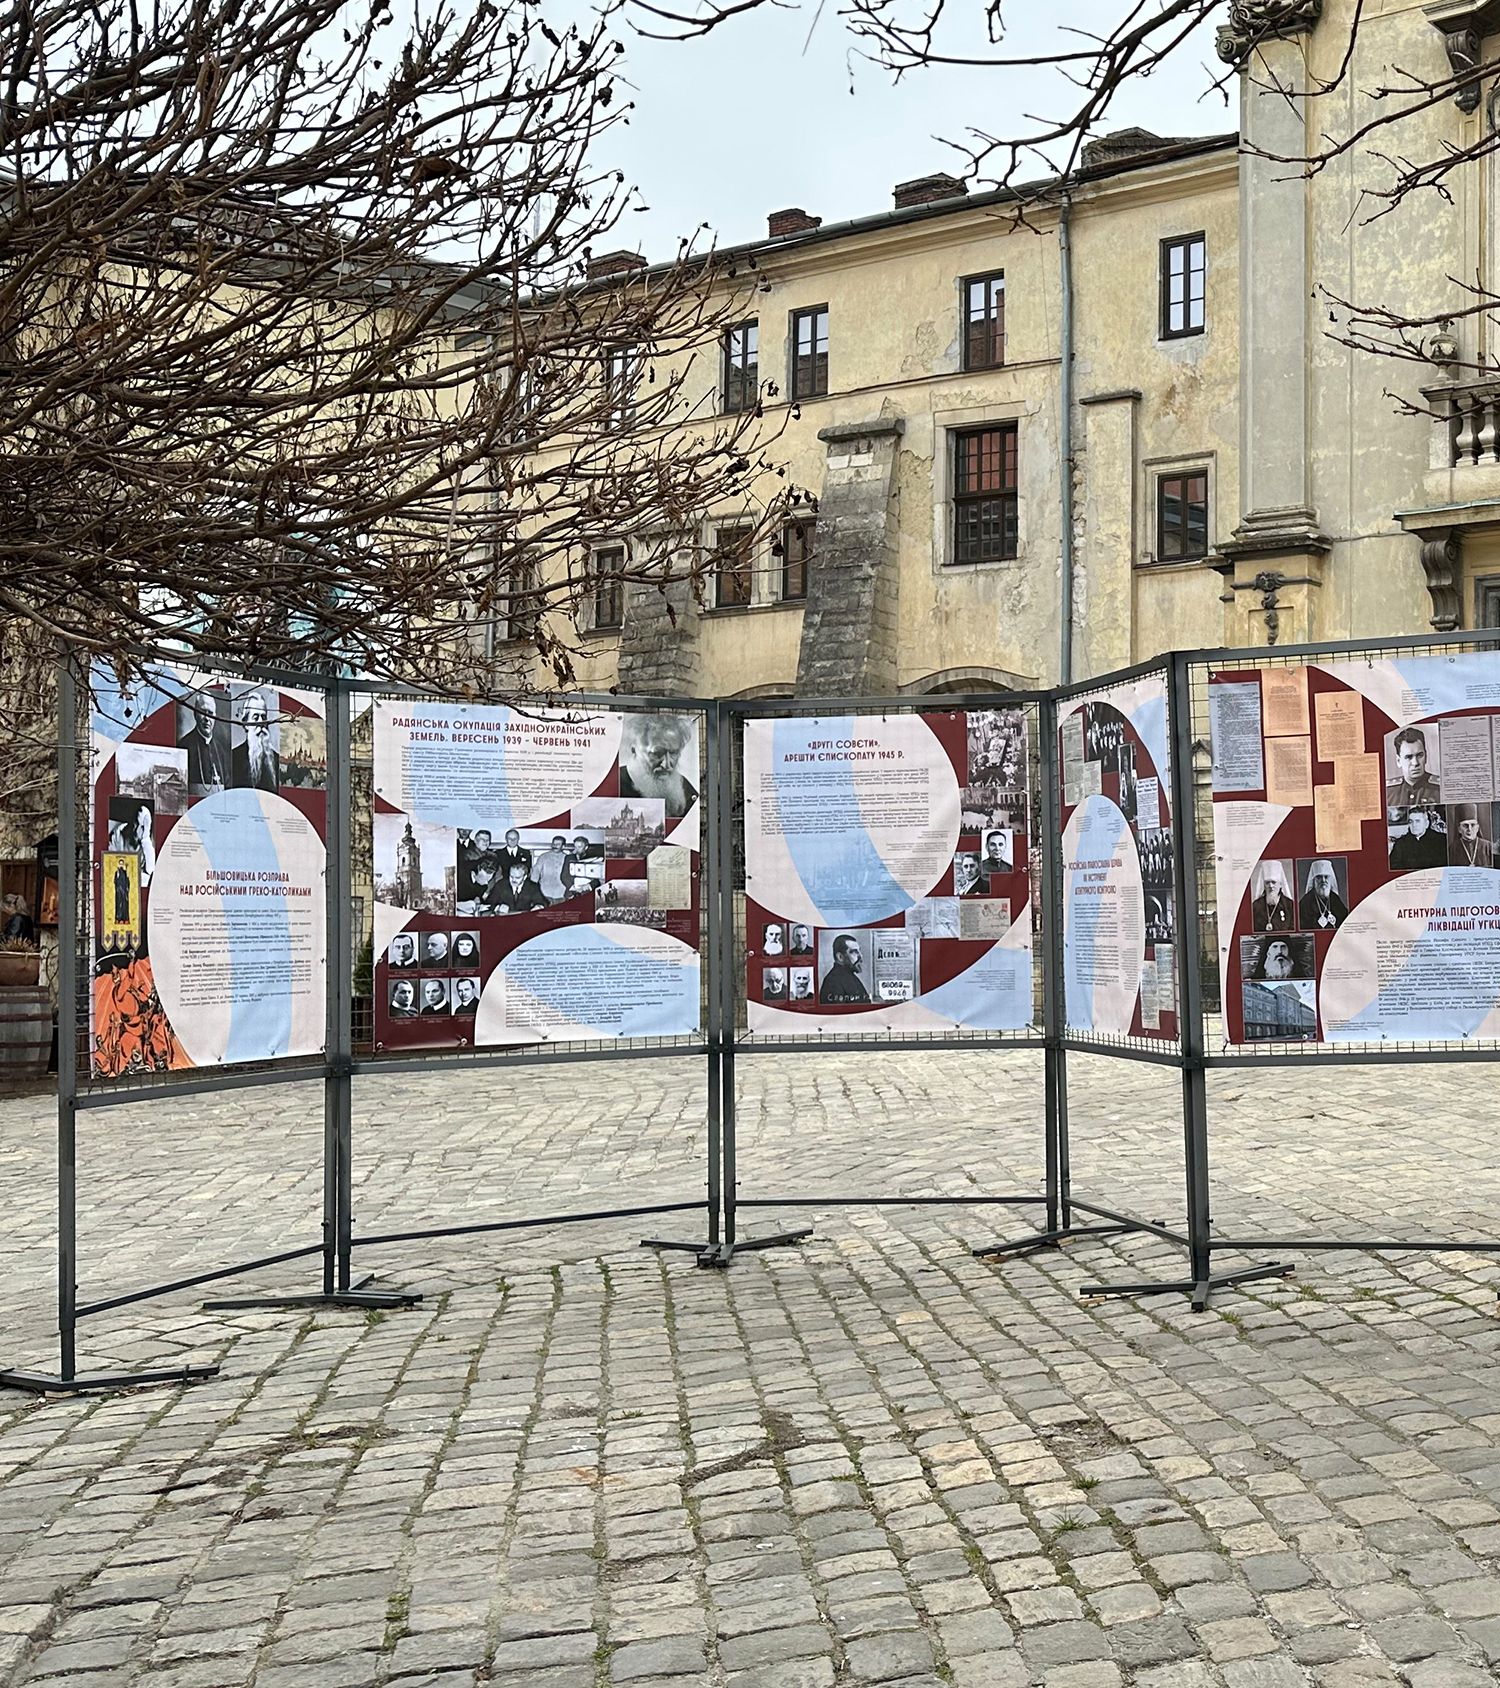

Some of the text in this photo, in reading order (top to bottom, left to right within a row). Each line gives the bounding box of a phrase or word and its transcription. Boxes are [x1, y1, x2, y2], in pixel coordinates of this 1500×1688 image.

[392, 718, 606, 735] РАДЯНСЬКА ОКУПАЦІЯ ЗАХІДНОУКРАЇНСЬКИХ
[409, 732, 448, 742] ЗЕМЕЛЬ.
[452, 734, 500, 744] ВЕРЕСЕНЬ
[503, 736, 522, 745] 1939
[533, 736, 570, 747] ЧЕРВЕНЬ
[574, 739, 591, 747] 1941
[808, 740, 833, 750] «ДРУГІ
[784, 753, 815, 762] АРЕШТИ
[818, 752, 876, 761] ЄПИСКОПАТУ
[878, 750, 895, 759] 1945
[206, 870, 290, 882] БІЛЬШОВИЦЬКА РОЗПРАВА
[180, 883, 312, 896] НАД РОСІЙСЬКИМИ ГРЕКО-КАТОЛИКАМИ
[1397, 907, 1448, 919] АГЕНТУРНА
[1428, 918, 1500, 932] ЛІКВІДАЦІЇ УГКЦ
